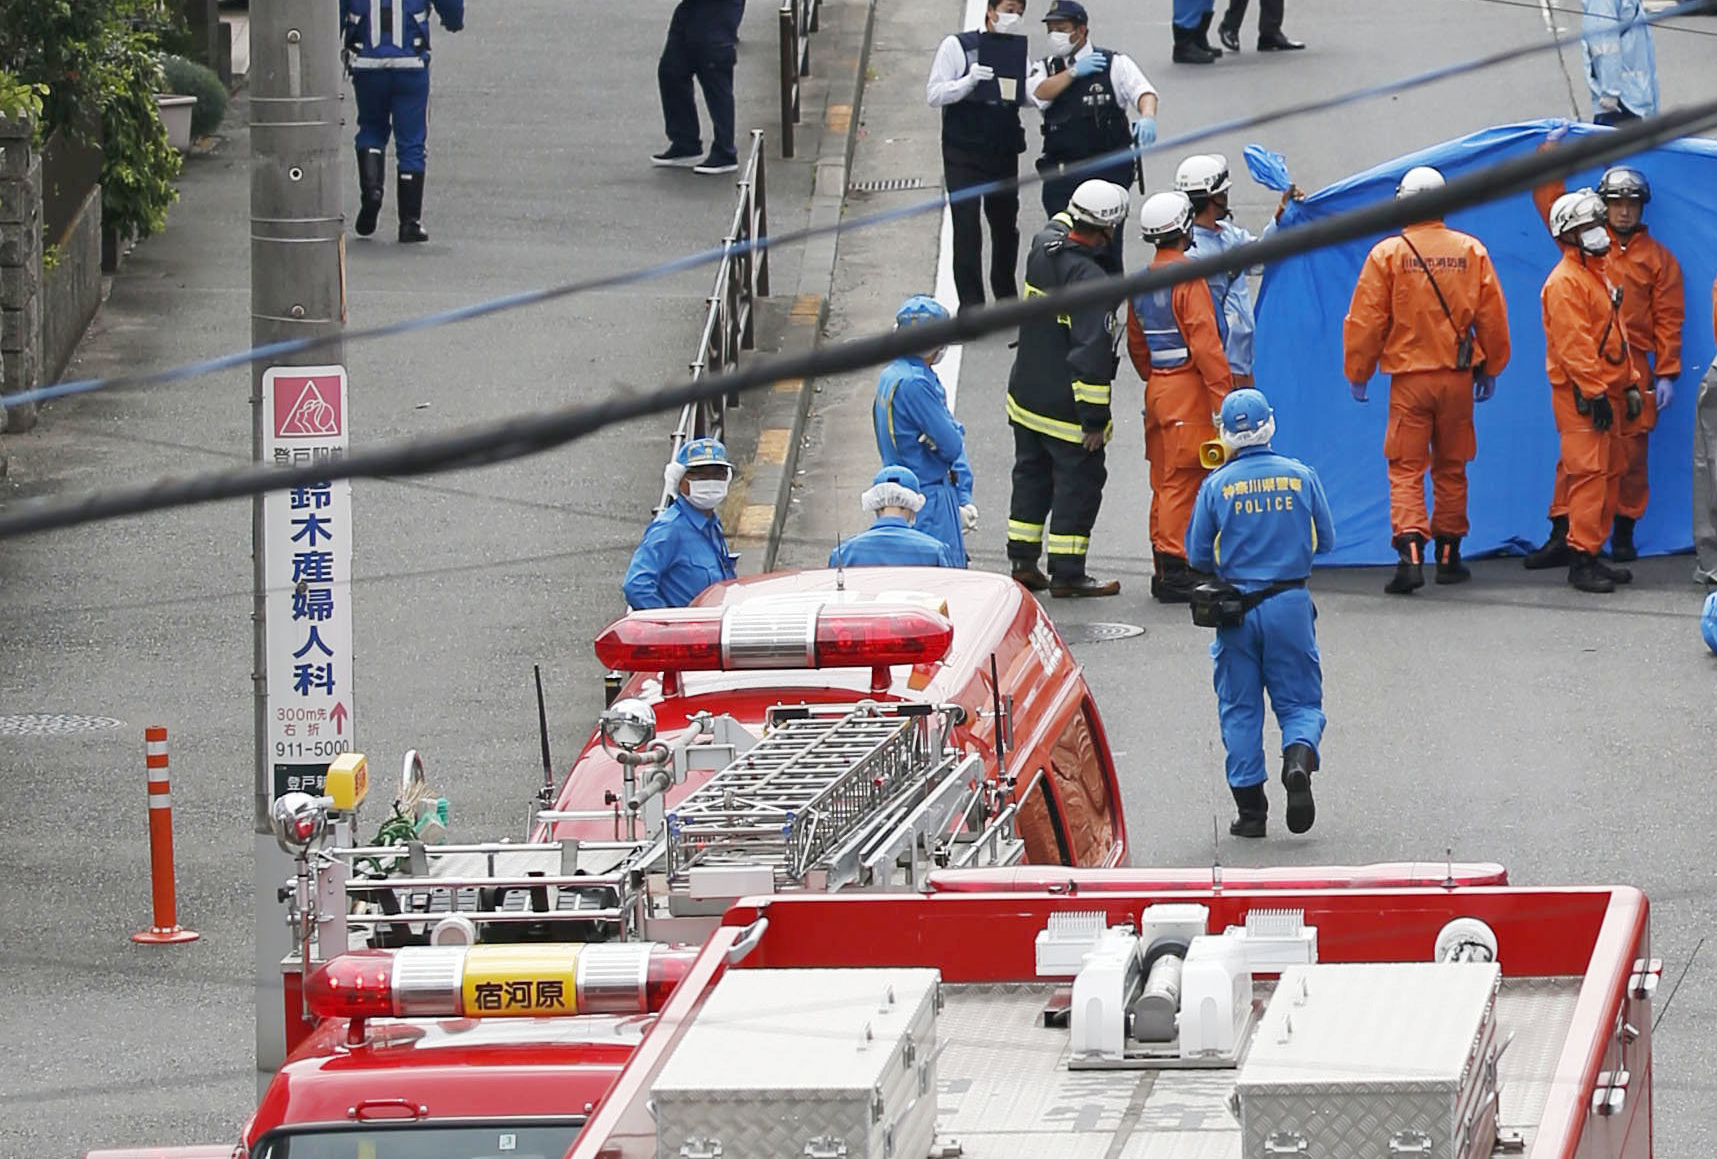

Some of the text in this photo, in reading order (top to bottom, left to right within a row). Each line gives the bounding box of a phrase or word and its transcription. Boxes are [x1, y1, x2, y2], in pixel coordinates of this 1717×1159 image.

[1235, 497, 1293, 514] POLICE
[290, 482, 336, 697] 鈴木産婦人科
[276, 708, 328, 722] 300m先
[275, 740, 349, 757] 911-5000
[475, 981, 566, 1010] 宿河原
